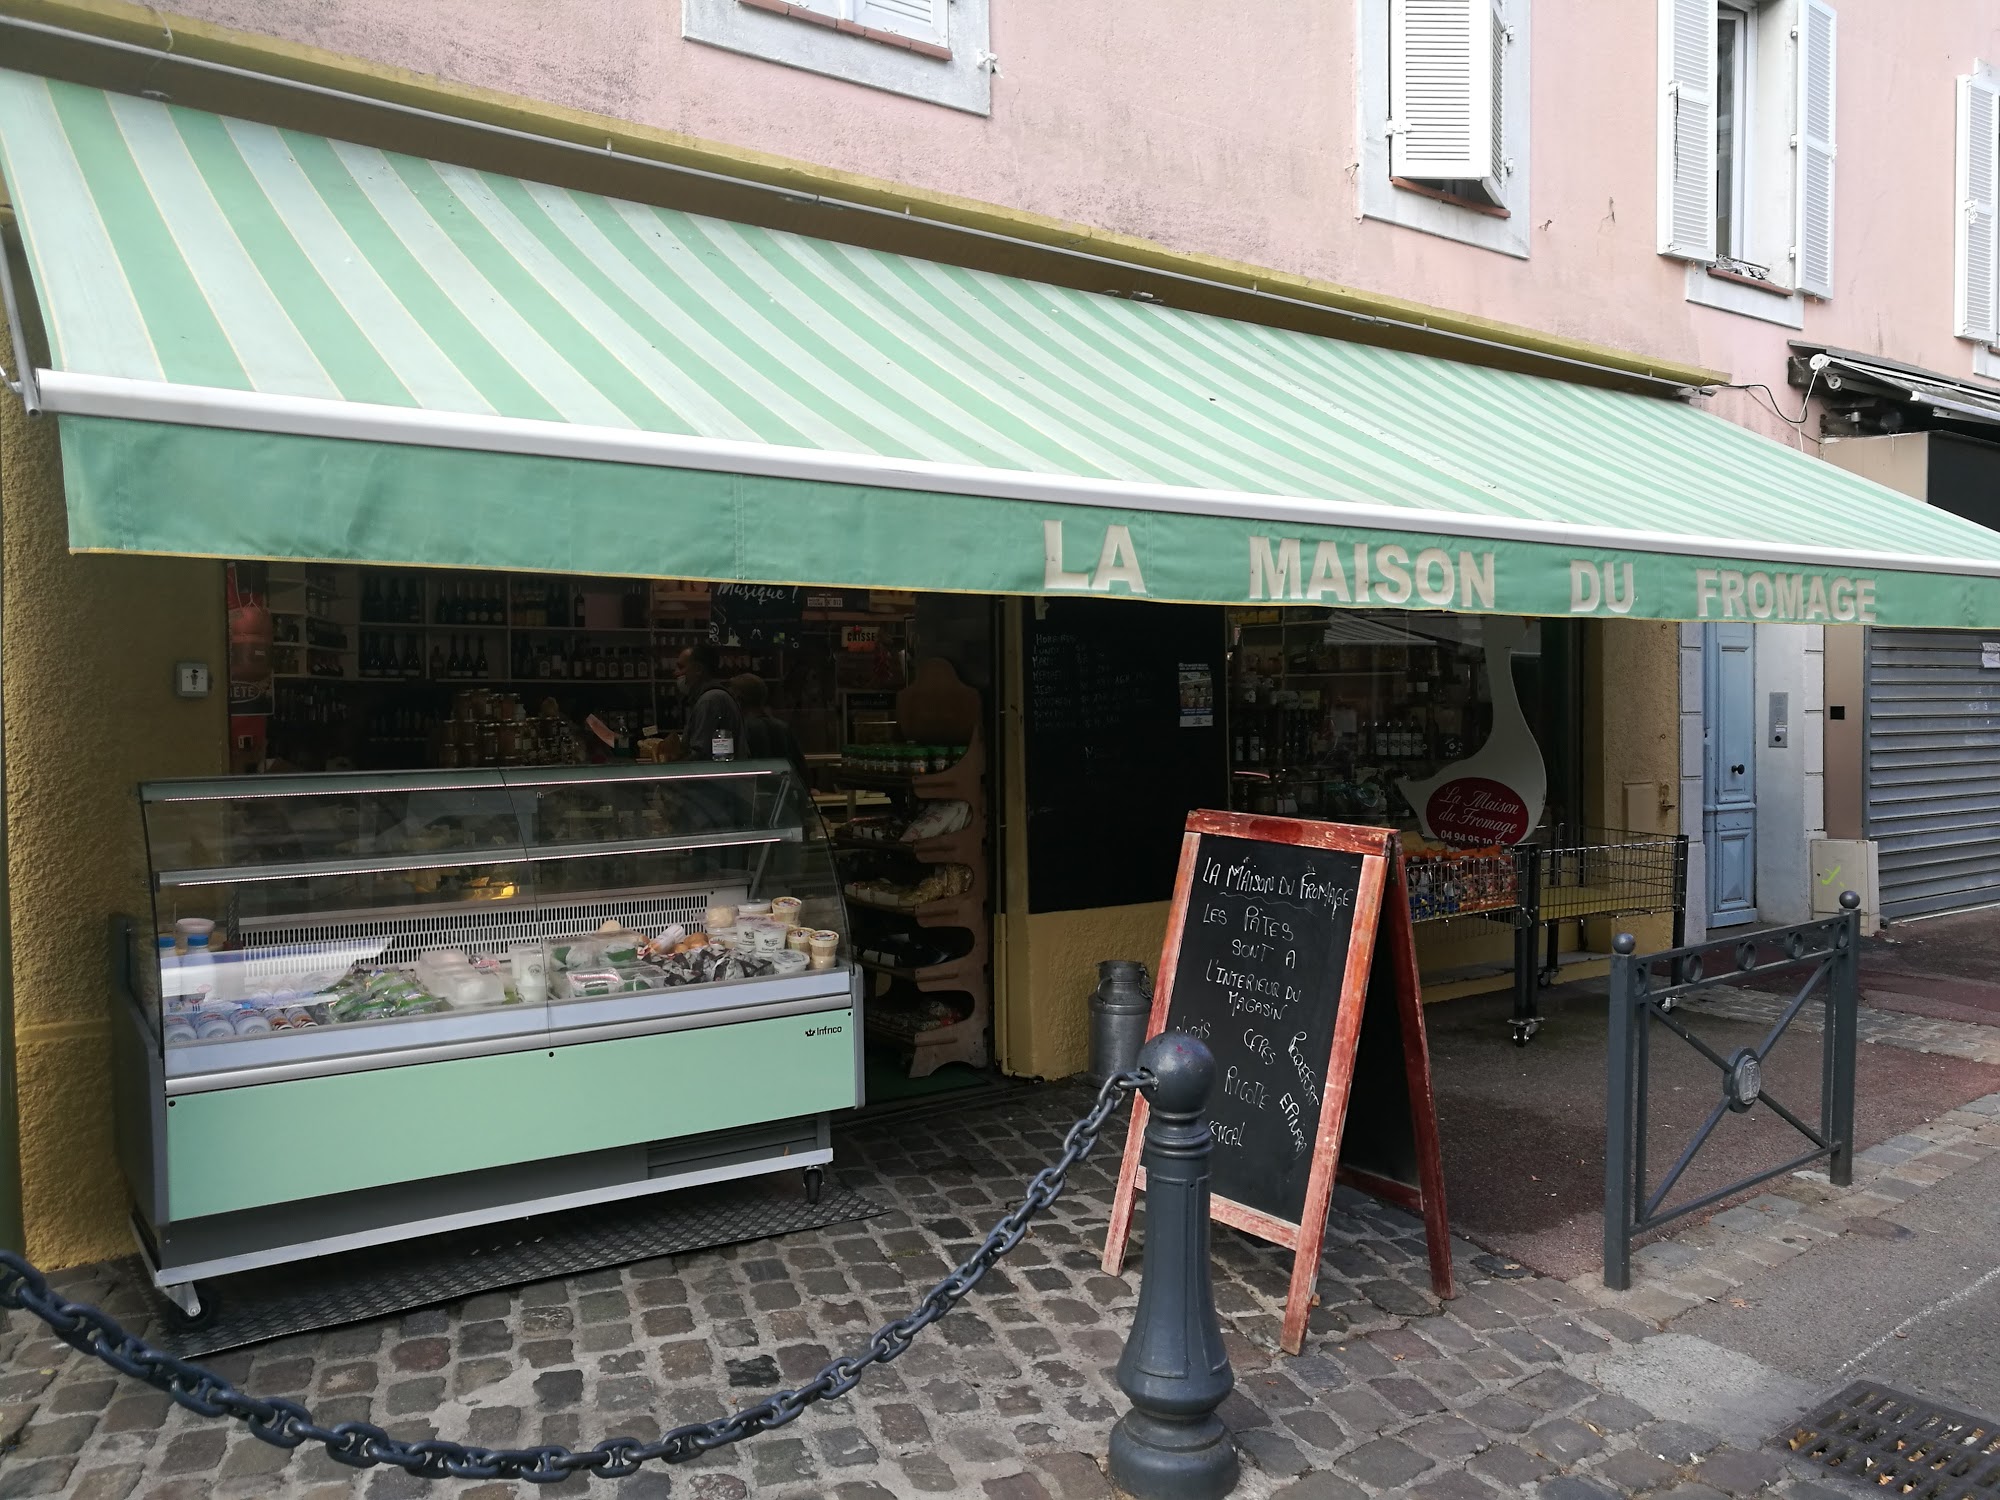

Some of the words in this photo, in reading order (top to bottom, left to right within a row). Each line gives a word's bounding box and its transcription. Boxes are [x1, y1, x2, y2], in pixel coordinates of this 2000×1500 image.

[1043, 519, 1147, 595] LA
[1248, 535, 1495, 608] MAISON
[1571, 557, 1635, 614] DU
[1697, 568, 1877, 623] FROMAGE
[717, 583, 785, 605] Musique
[847, 632, 875, 642] CAISSE
[1440, 786, 1462, 805] La
[1463, 790, 1519, 815] Maison
[1439, 804, 1456, 822] du
[1457, 807, 1518, 840] Fromage
[1441, 829, 1452, 840] 04
[1454, 832, 1466, 842] 94
[1203, 857, 1221, 885] LA
[1226, 864, 1275, 893] MAISON
[1279, 876, 1296, 896] DU
[1300, 872, 1354, 908] FROMAGE
[1203, 903, 1228, 925] LES
[1232, 938, 1274, 961] SONT
[1285, 949, 1296, 969] A
[1206, 959, 1280, 998] L'INTERIEUR
[1286, 985, 1302, 1002] DU
[1228, 991, 1288, 1020] MAGASIN
[816, 1025, 842, 1036] Infrico
